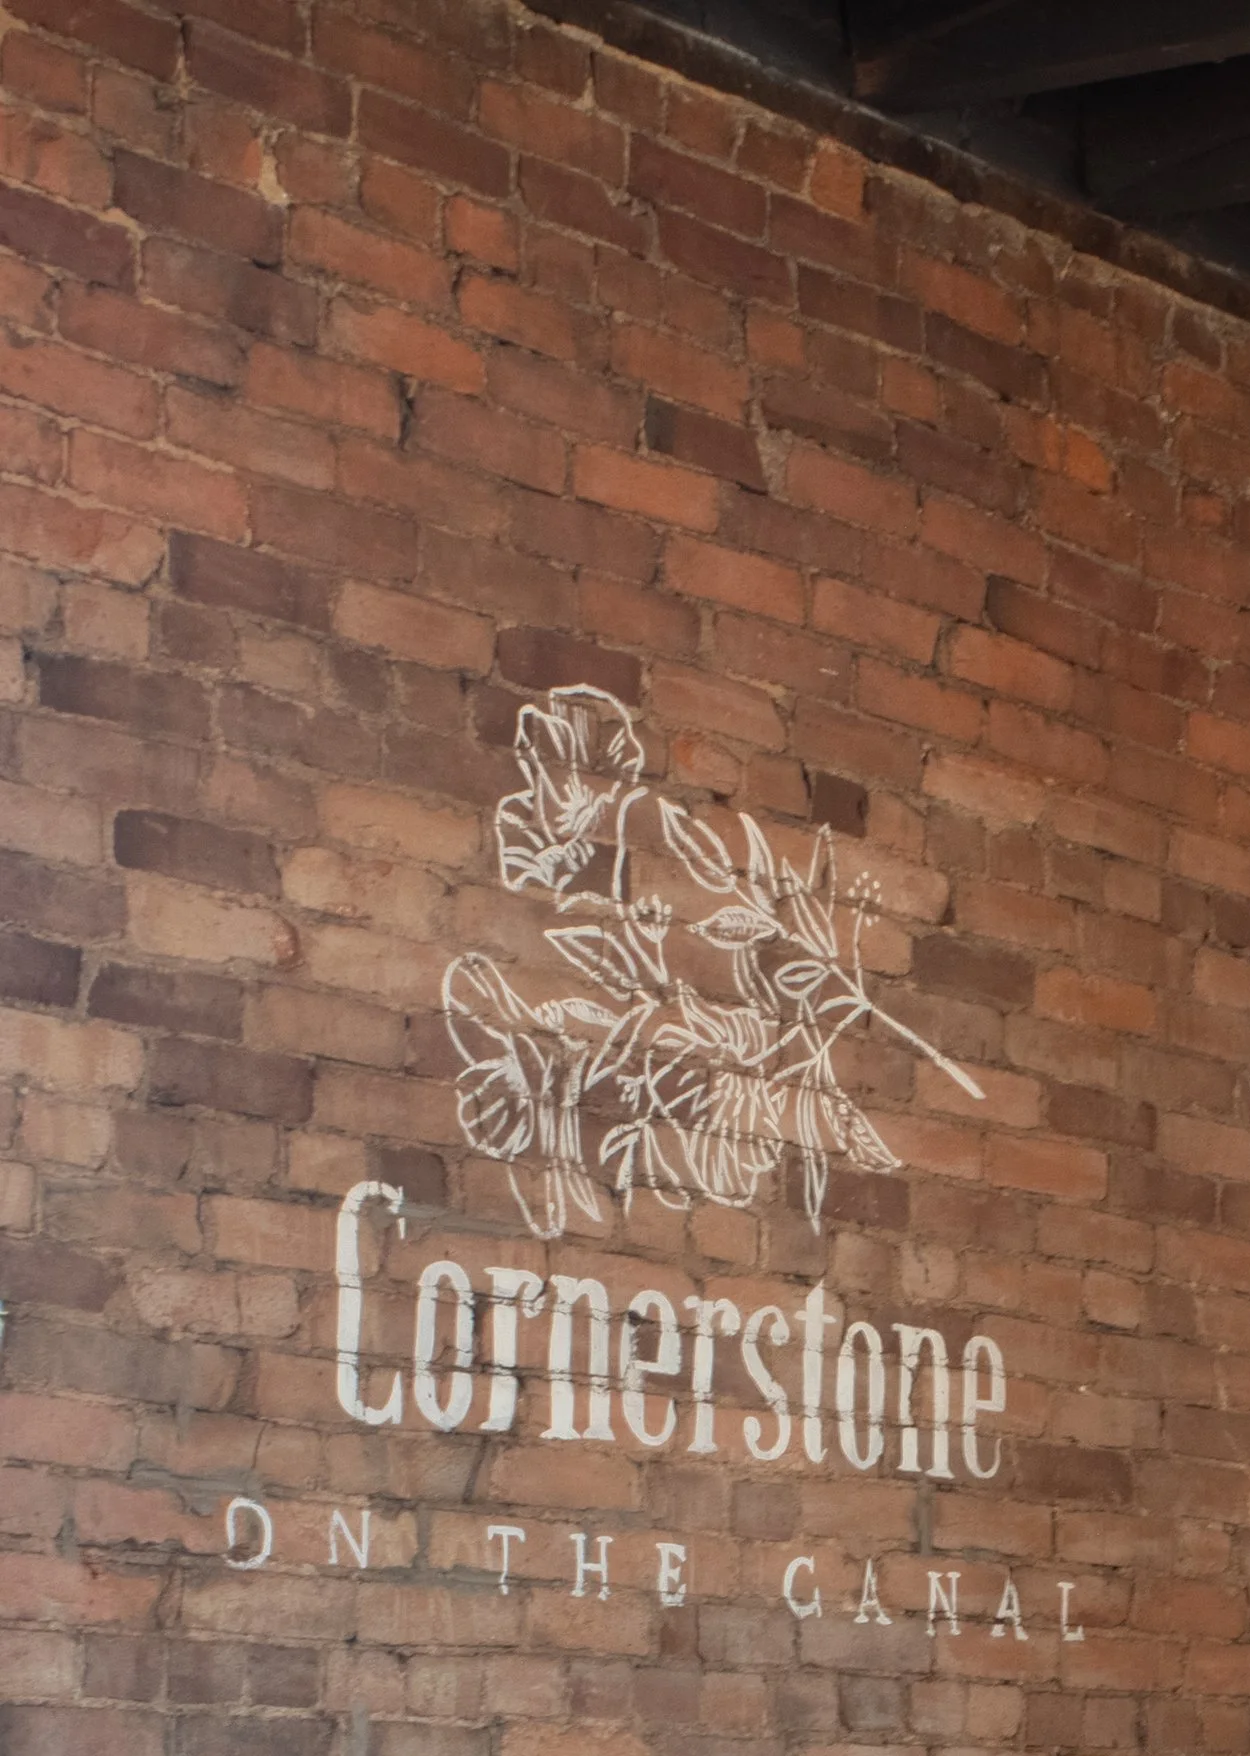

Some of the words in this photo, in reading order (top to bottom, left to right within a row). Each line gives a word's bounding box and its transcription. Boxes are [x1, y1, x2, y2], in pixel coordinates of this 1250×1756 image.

[334, 1180, 1007, 1481] Cornerstone
[225, 1497, 370, 1570] ON
[487, 1524, 686, 1607] THE
[783, 1556, 1085, 1642] CANAL
